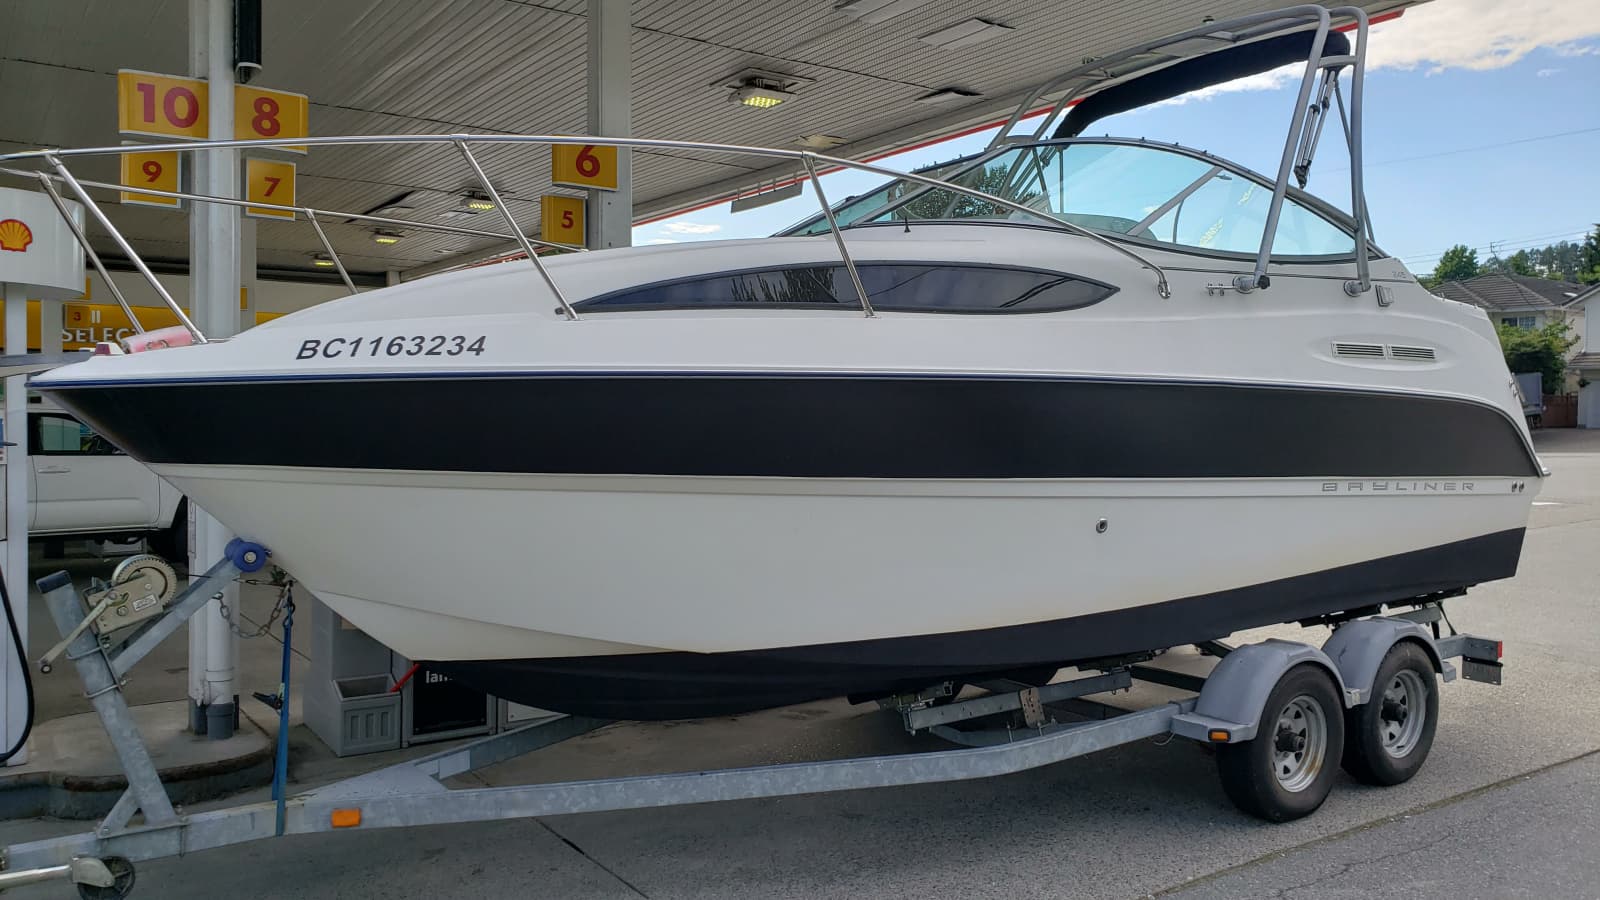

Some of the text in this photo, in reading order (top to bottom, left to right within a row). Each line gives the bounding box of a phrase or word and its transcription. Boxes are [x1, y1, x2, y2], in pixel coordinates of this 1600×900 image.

[136, 82, 199, 129] 10
[251, 96, 281, 137] 8
[142, 160, 162, 183] 9
[575, 144, 601, 178] 6
[263, 176, 281, 197] 7
[560, 210, 575, 230] 5
[73, 311, 82, 322] 3
[295, 335, 487, 361] BC1163234
[1321, 481, 1475, 492] BAYLINER
